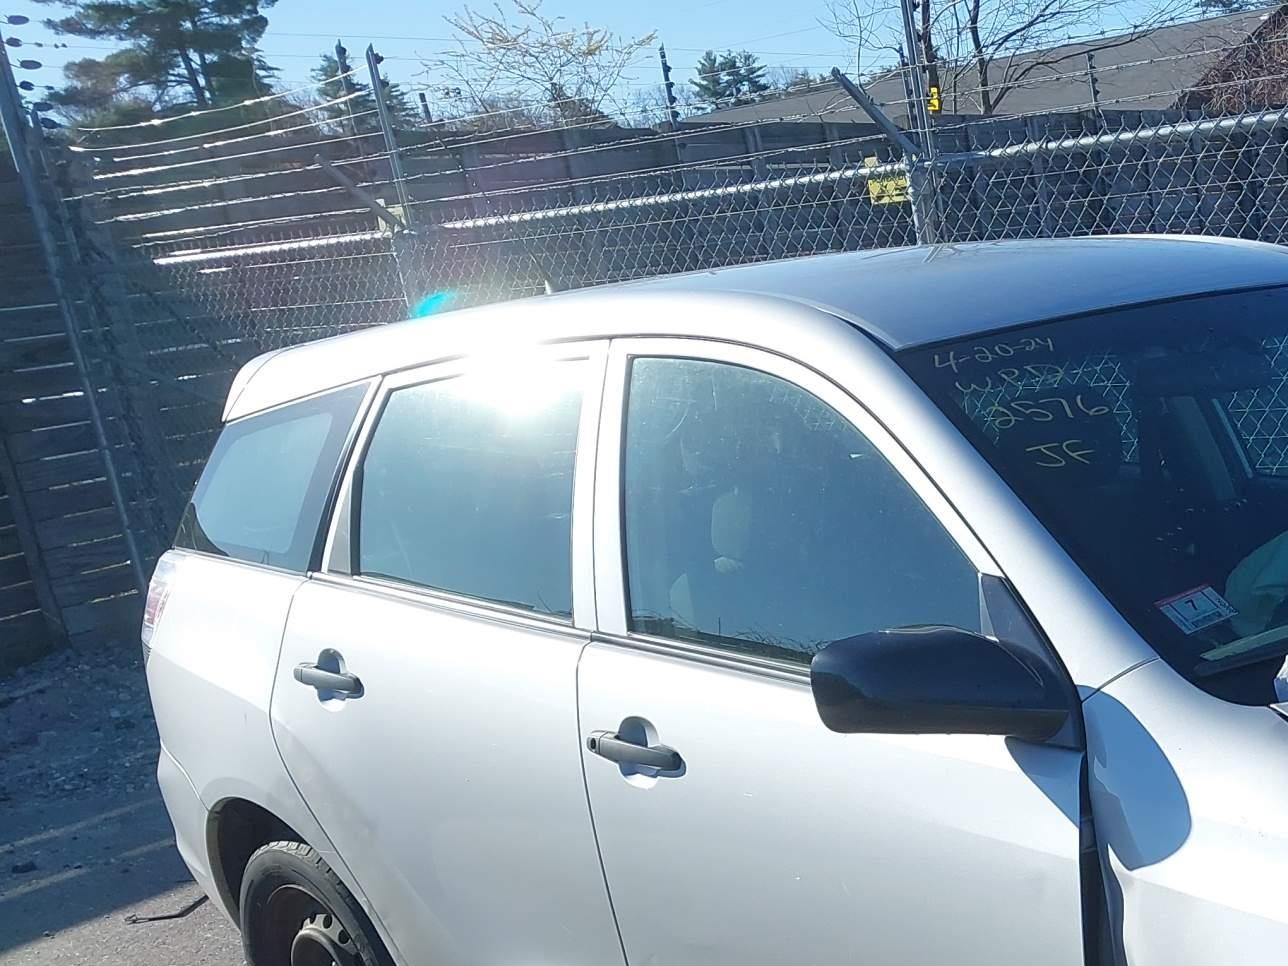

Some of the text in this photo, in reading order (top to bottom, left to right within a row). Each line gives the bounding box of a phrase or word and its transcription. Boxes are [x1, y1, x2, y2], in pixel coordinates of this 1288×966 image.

[934, 336, 1055, 374] 4-20-24
[987, 394, 1109, 430] 2576
[1026, 439, 1094, 467] JF
[1184, 599, 1198, 611] 7
